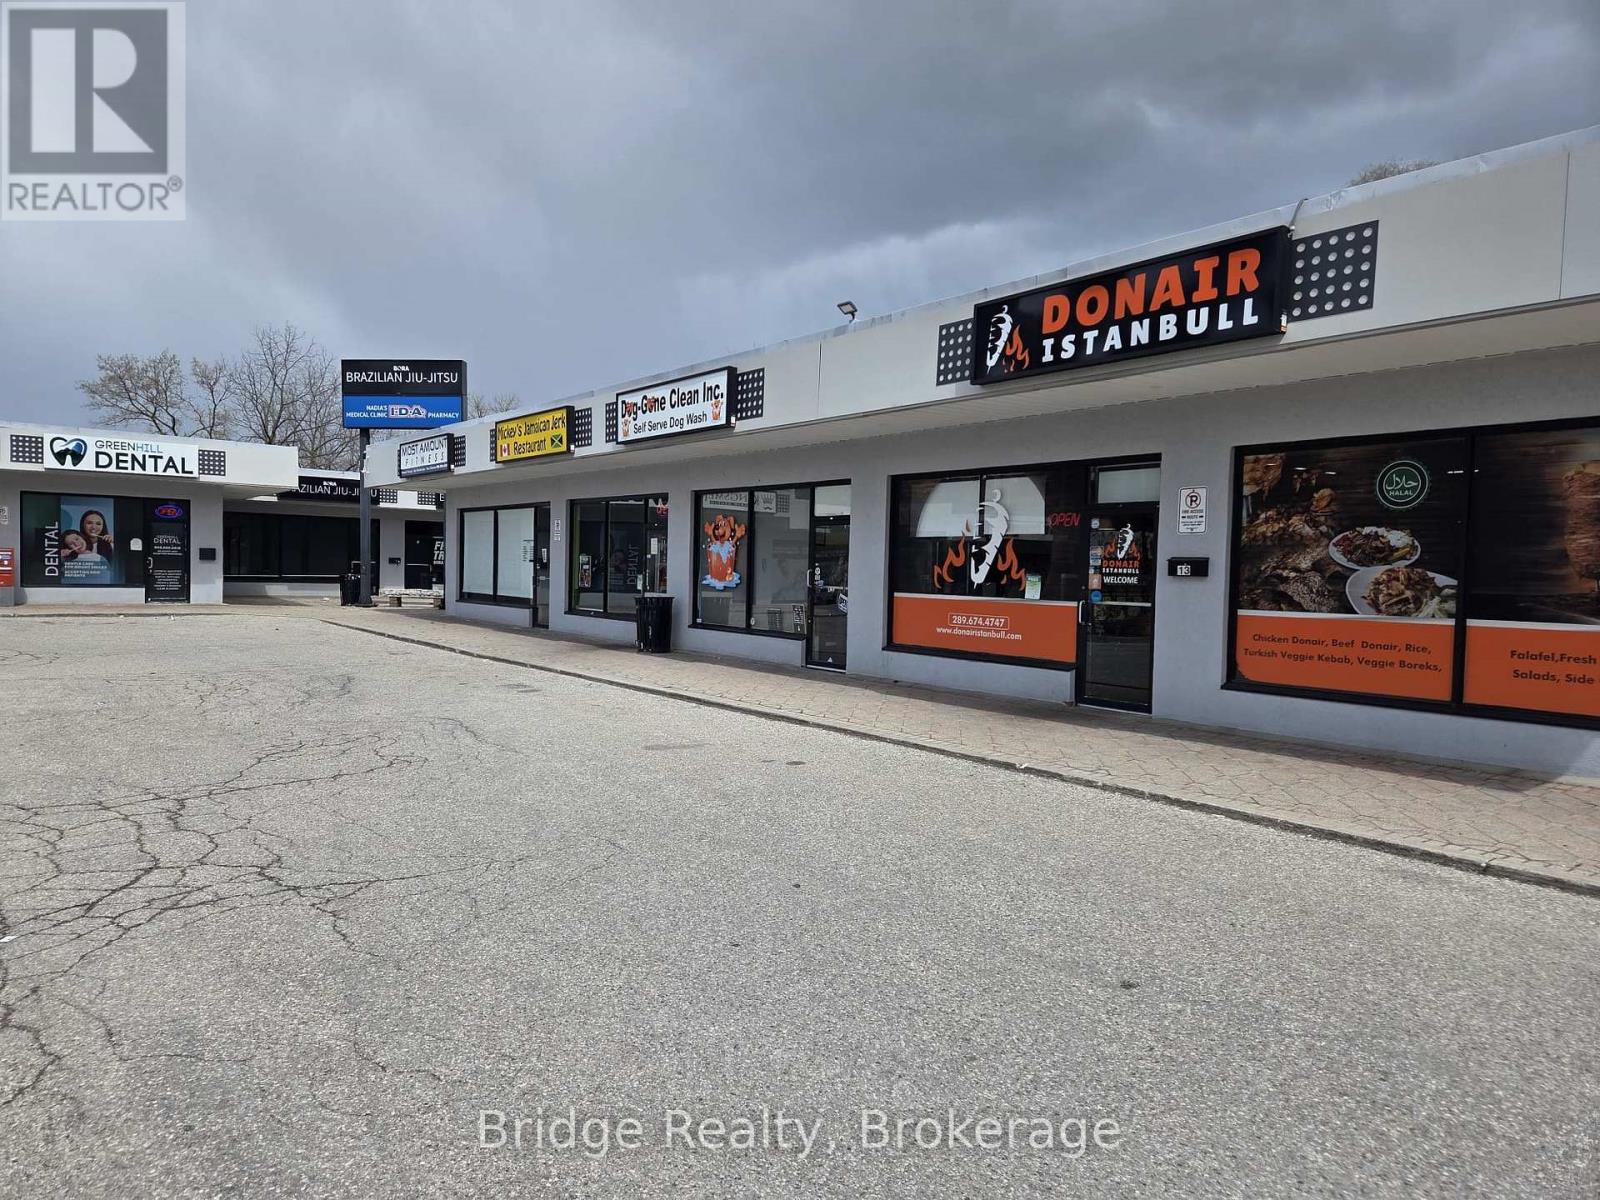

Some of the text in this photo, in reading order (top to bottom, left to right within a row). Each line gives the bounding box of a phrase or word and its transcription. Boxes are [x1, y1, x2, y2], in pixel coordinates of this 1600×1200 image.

[1041, 248, 1261, 335] DONAIR
[1041, 298, 1259, 364] ISTANBULL
[345, 371, 458, 384] BRAZILIAN JIU-JITSU
[669, 387, 699, 410] Clean
[703, 381, 724, 402] Inc.
[366, 404, 388, 412] NADIA'S
[427, 411, 460, 419] PHARMACY
[497, 412, 566, 440] Mickey's Jamaican Jerk
[633, 411, 708, 434] Self Serve Dog Wash
[94, 440, 164, 454] GREENHILL
[401, 437, 448, 457] MOST AMOUNT
[513, 437, 547, 456] Restaurant
[94, 451, 195, 475] DENTAL
[405, 451, 444, 467] FITNESS
[1385, 473, 1419, 490] حلال
[333, 485, 378, 498] JIU-JIU
[1389, 489, 1414, 497] HALAL
[1048, 511, 1080, 528] OPEN
[44, 521, 59, 577] DENTAL
[153, 537, 181, 545] DENTAL
[1102, 560, 1139, 568] DONAIR
[1177, 566, 1190, 575] 13
[1103, 576, 1139, 584] WELCOME
[951, 615, 1005, 627] 289.674.4747
[936, 627, 1022, 640] www.donairistanbull.com
[1252, 633, 1432, 655] Chicken Donair, Beef Donair, Rice,
[1243, 648, 1443, 673] Turkish Veggie Kebab, Veggie Boreks,
[1512, 668, 1595, 685] Salads, Side
